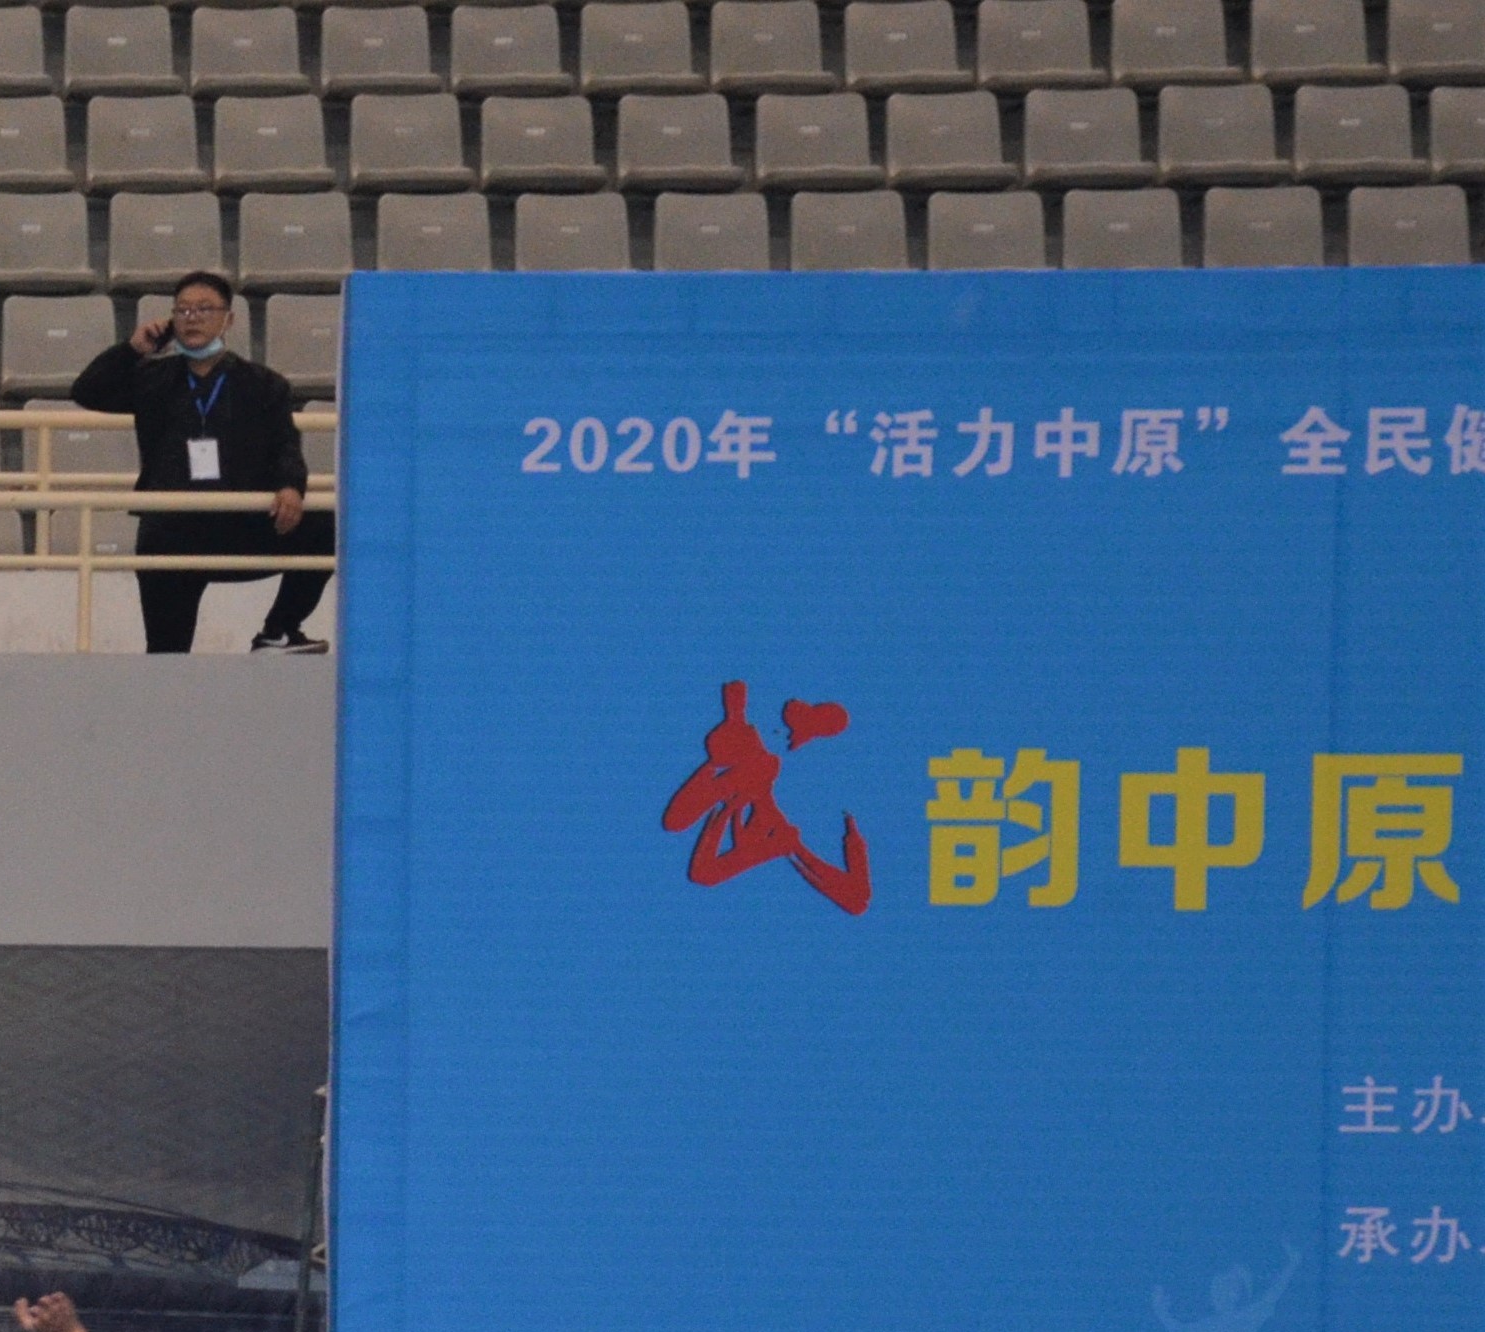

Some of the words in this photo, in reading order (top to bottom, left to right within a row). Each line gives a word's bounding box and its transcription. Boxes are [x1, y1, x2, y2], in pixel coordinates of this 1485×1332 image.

[522, 408, 777, 479] 2020年
[1339, 1076, 1485, 1134] 主办
[1339, 1206, 1485, 1263] 承办
